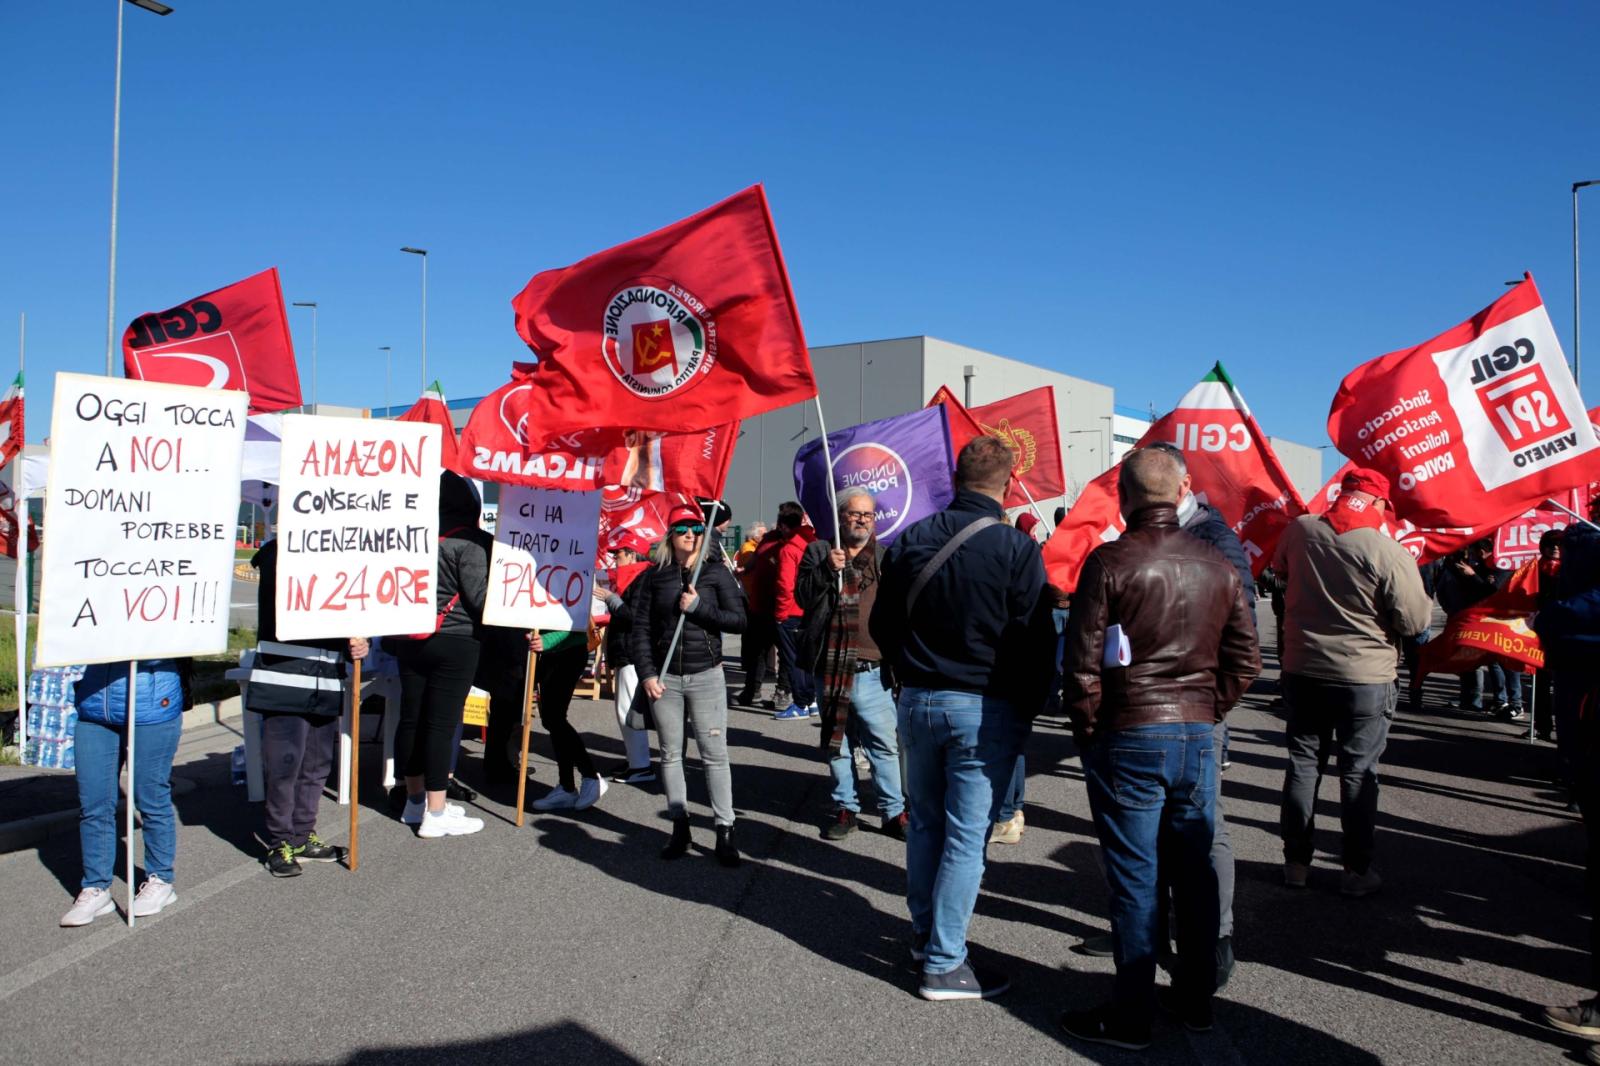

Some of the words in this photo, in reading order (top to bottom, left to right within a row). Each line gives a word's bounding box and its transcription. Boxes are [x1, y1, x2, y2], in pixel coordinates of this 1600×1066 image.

[76, 393, 146, 426] OGGI
[164, 404, 235, 428] TOCCA
[96, 442, 118, 472] A
[300, 435, 428, 478] AMAZON
[64, 488, 151, 512] DOMANI
[293, 487, 392, 514] CONSEGNE
[405, 493, 419, 510] E
[519, 503, 535, 518] CI
[545, 505, 563, 524] HA
[121, 521, 225, 541] POTREBBE
[287, 525, 429, 554] LICENZIAMENTI
[509, 531, 560, 553] TIRATO
[569, 539, 584, 556] IL
[74, 558, 197, 579] TOCCARE
[287, 574, 318, 611] IN
[319, 565, 370, 611] 24
[376, 566, 430, 606] ORE
[72, 598, 98, 628] A
